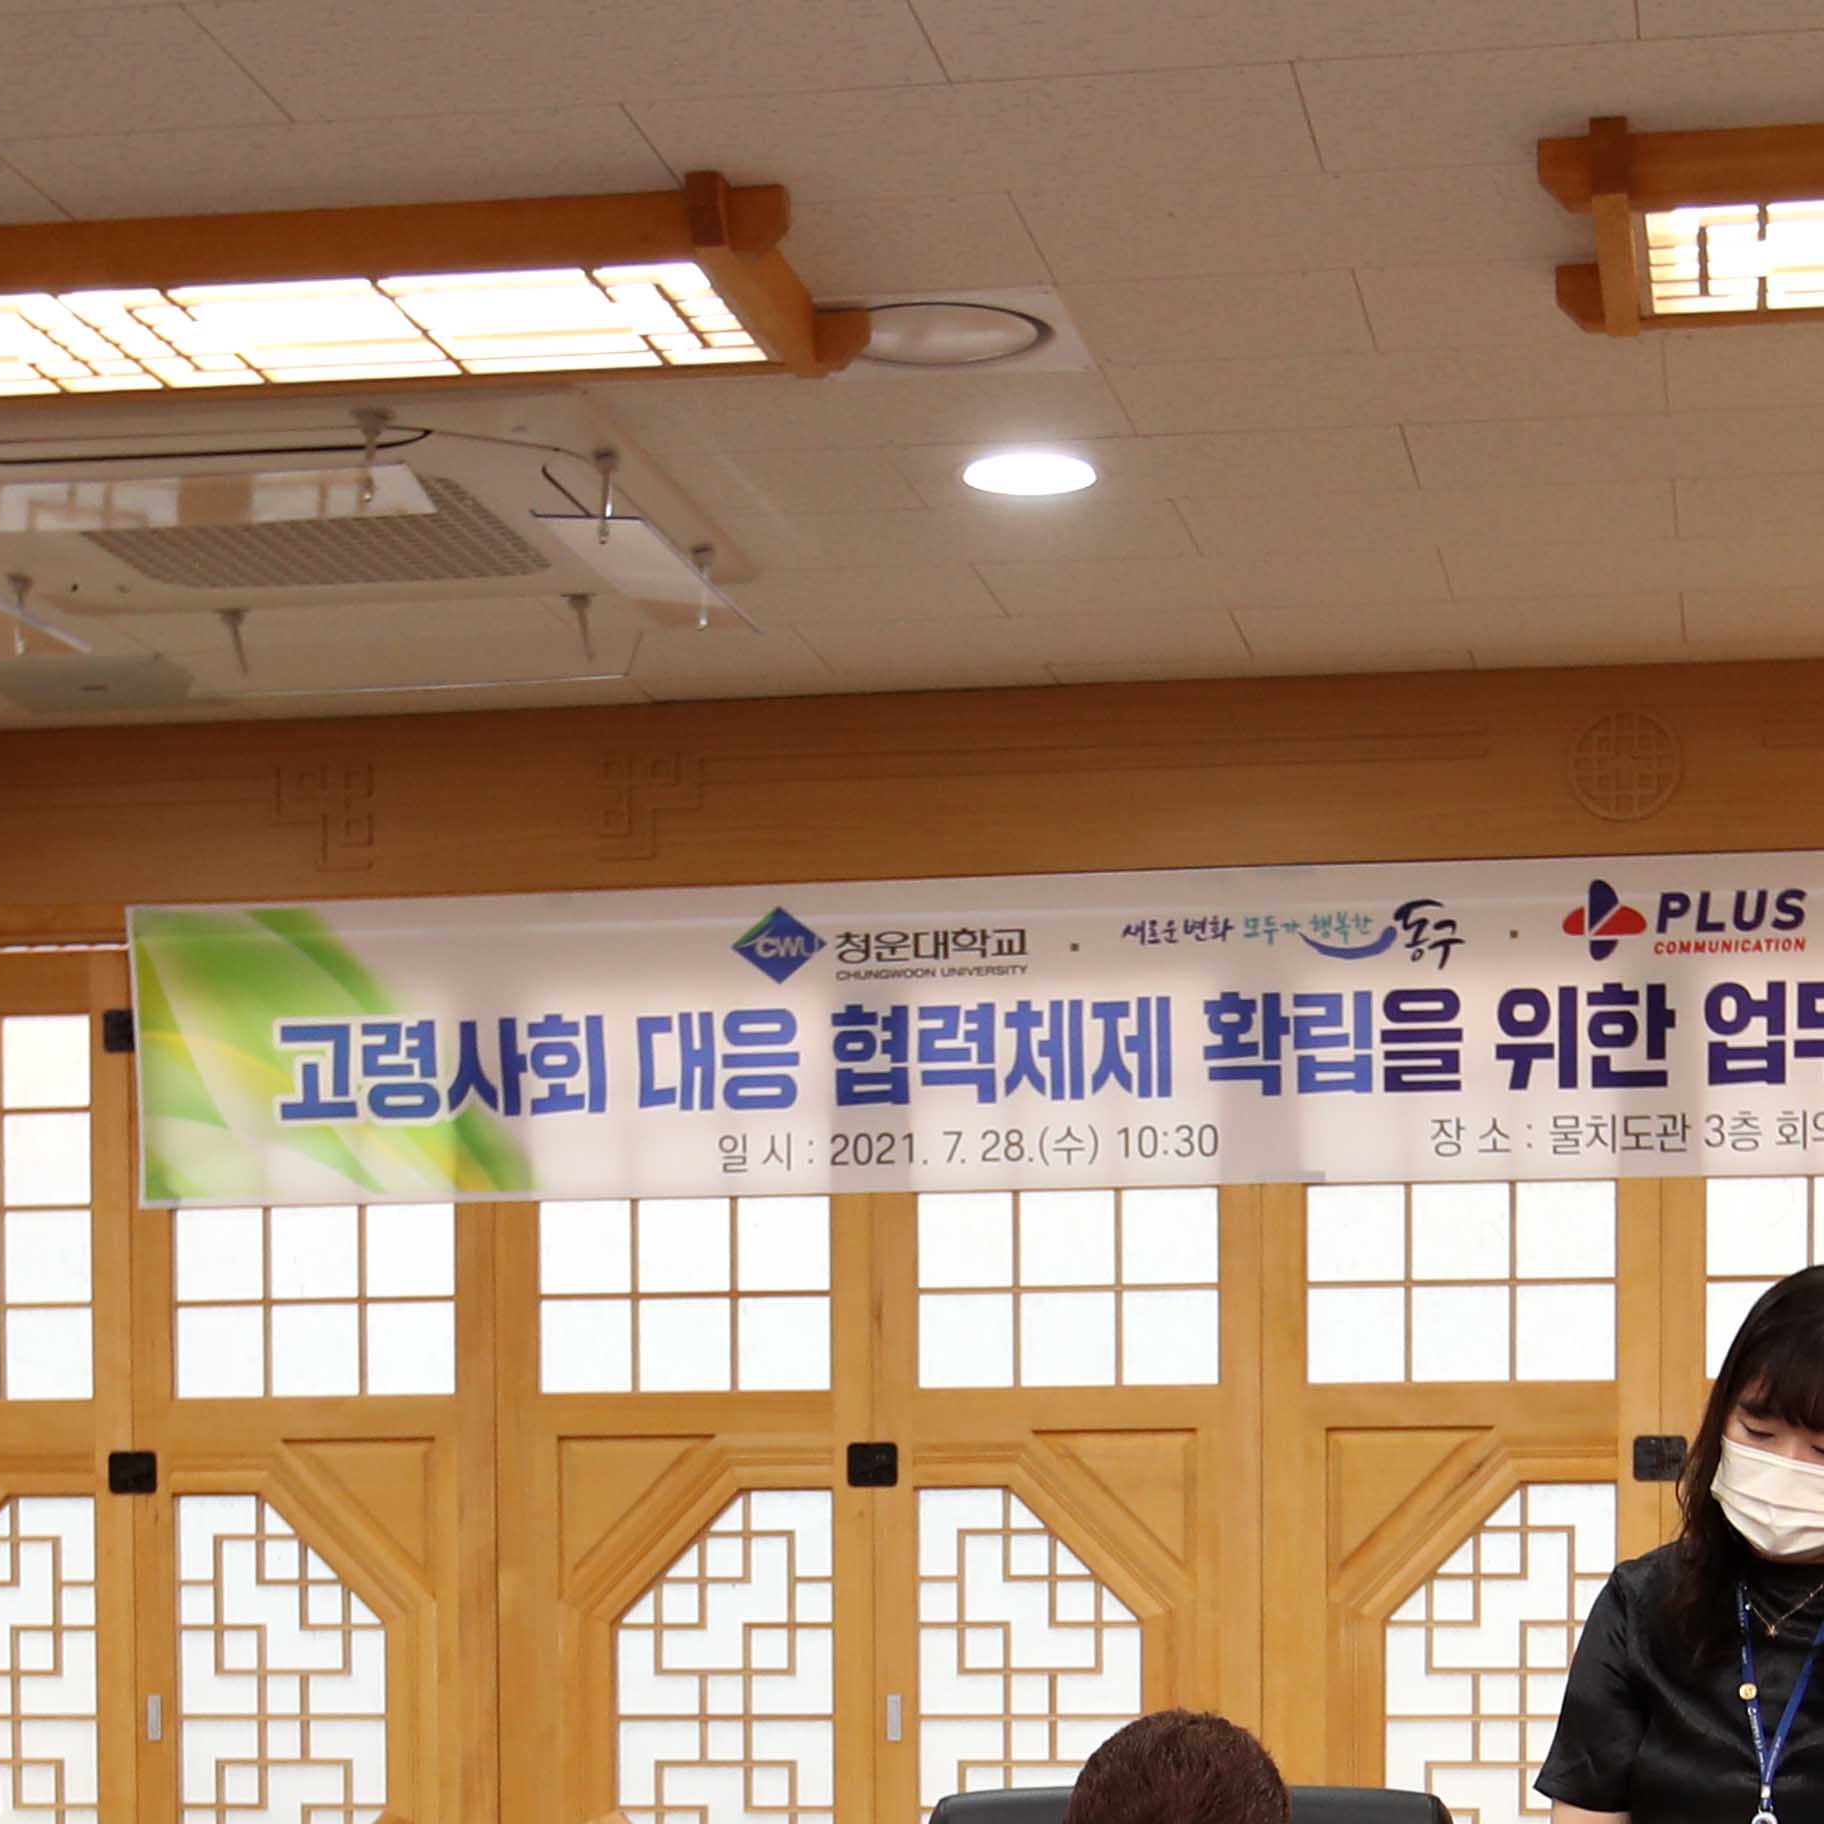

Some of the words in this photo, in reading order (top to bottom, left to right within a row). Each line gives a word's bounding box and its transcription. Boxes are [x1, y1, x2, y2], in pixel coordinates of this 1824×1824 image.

[1656, 888, 1807, 934] PLUS
[835, 928, 1027, 964] 청운대학교
[1121, 919, 1179, 946] 새로운
[1183, 915, 1234, 943] 변화
[1309, 911, 1373, 944] 행복한
[1392, 899, 1465, 970] 동구
[1653, 937, 1807, 955] COMMUNICATION
[836, 967, 936, 981] CHUNGWOON
[940, 965, 1027, 979] UNIVERSITY
[280, 1013, 608, 1121] 고령사회
[635, 1008, 800, 1111] 대응
[830, 996, 1173, 1106] 협력체제
[1203, 988, 1464, 1097] 확립을
[1494, 981, 1677, 1091] 위한
[1117, 1123, 1220, 1160] 10:30
[1548, 1113, 1692, 1155] 물치도관
[1704, 1110, 1763, 1153] 3층
